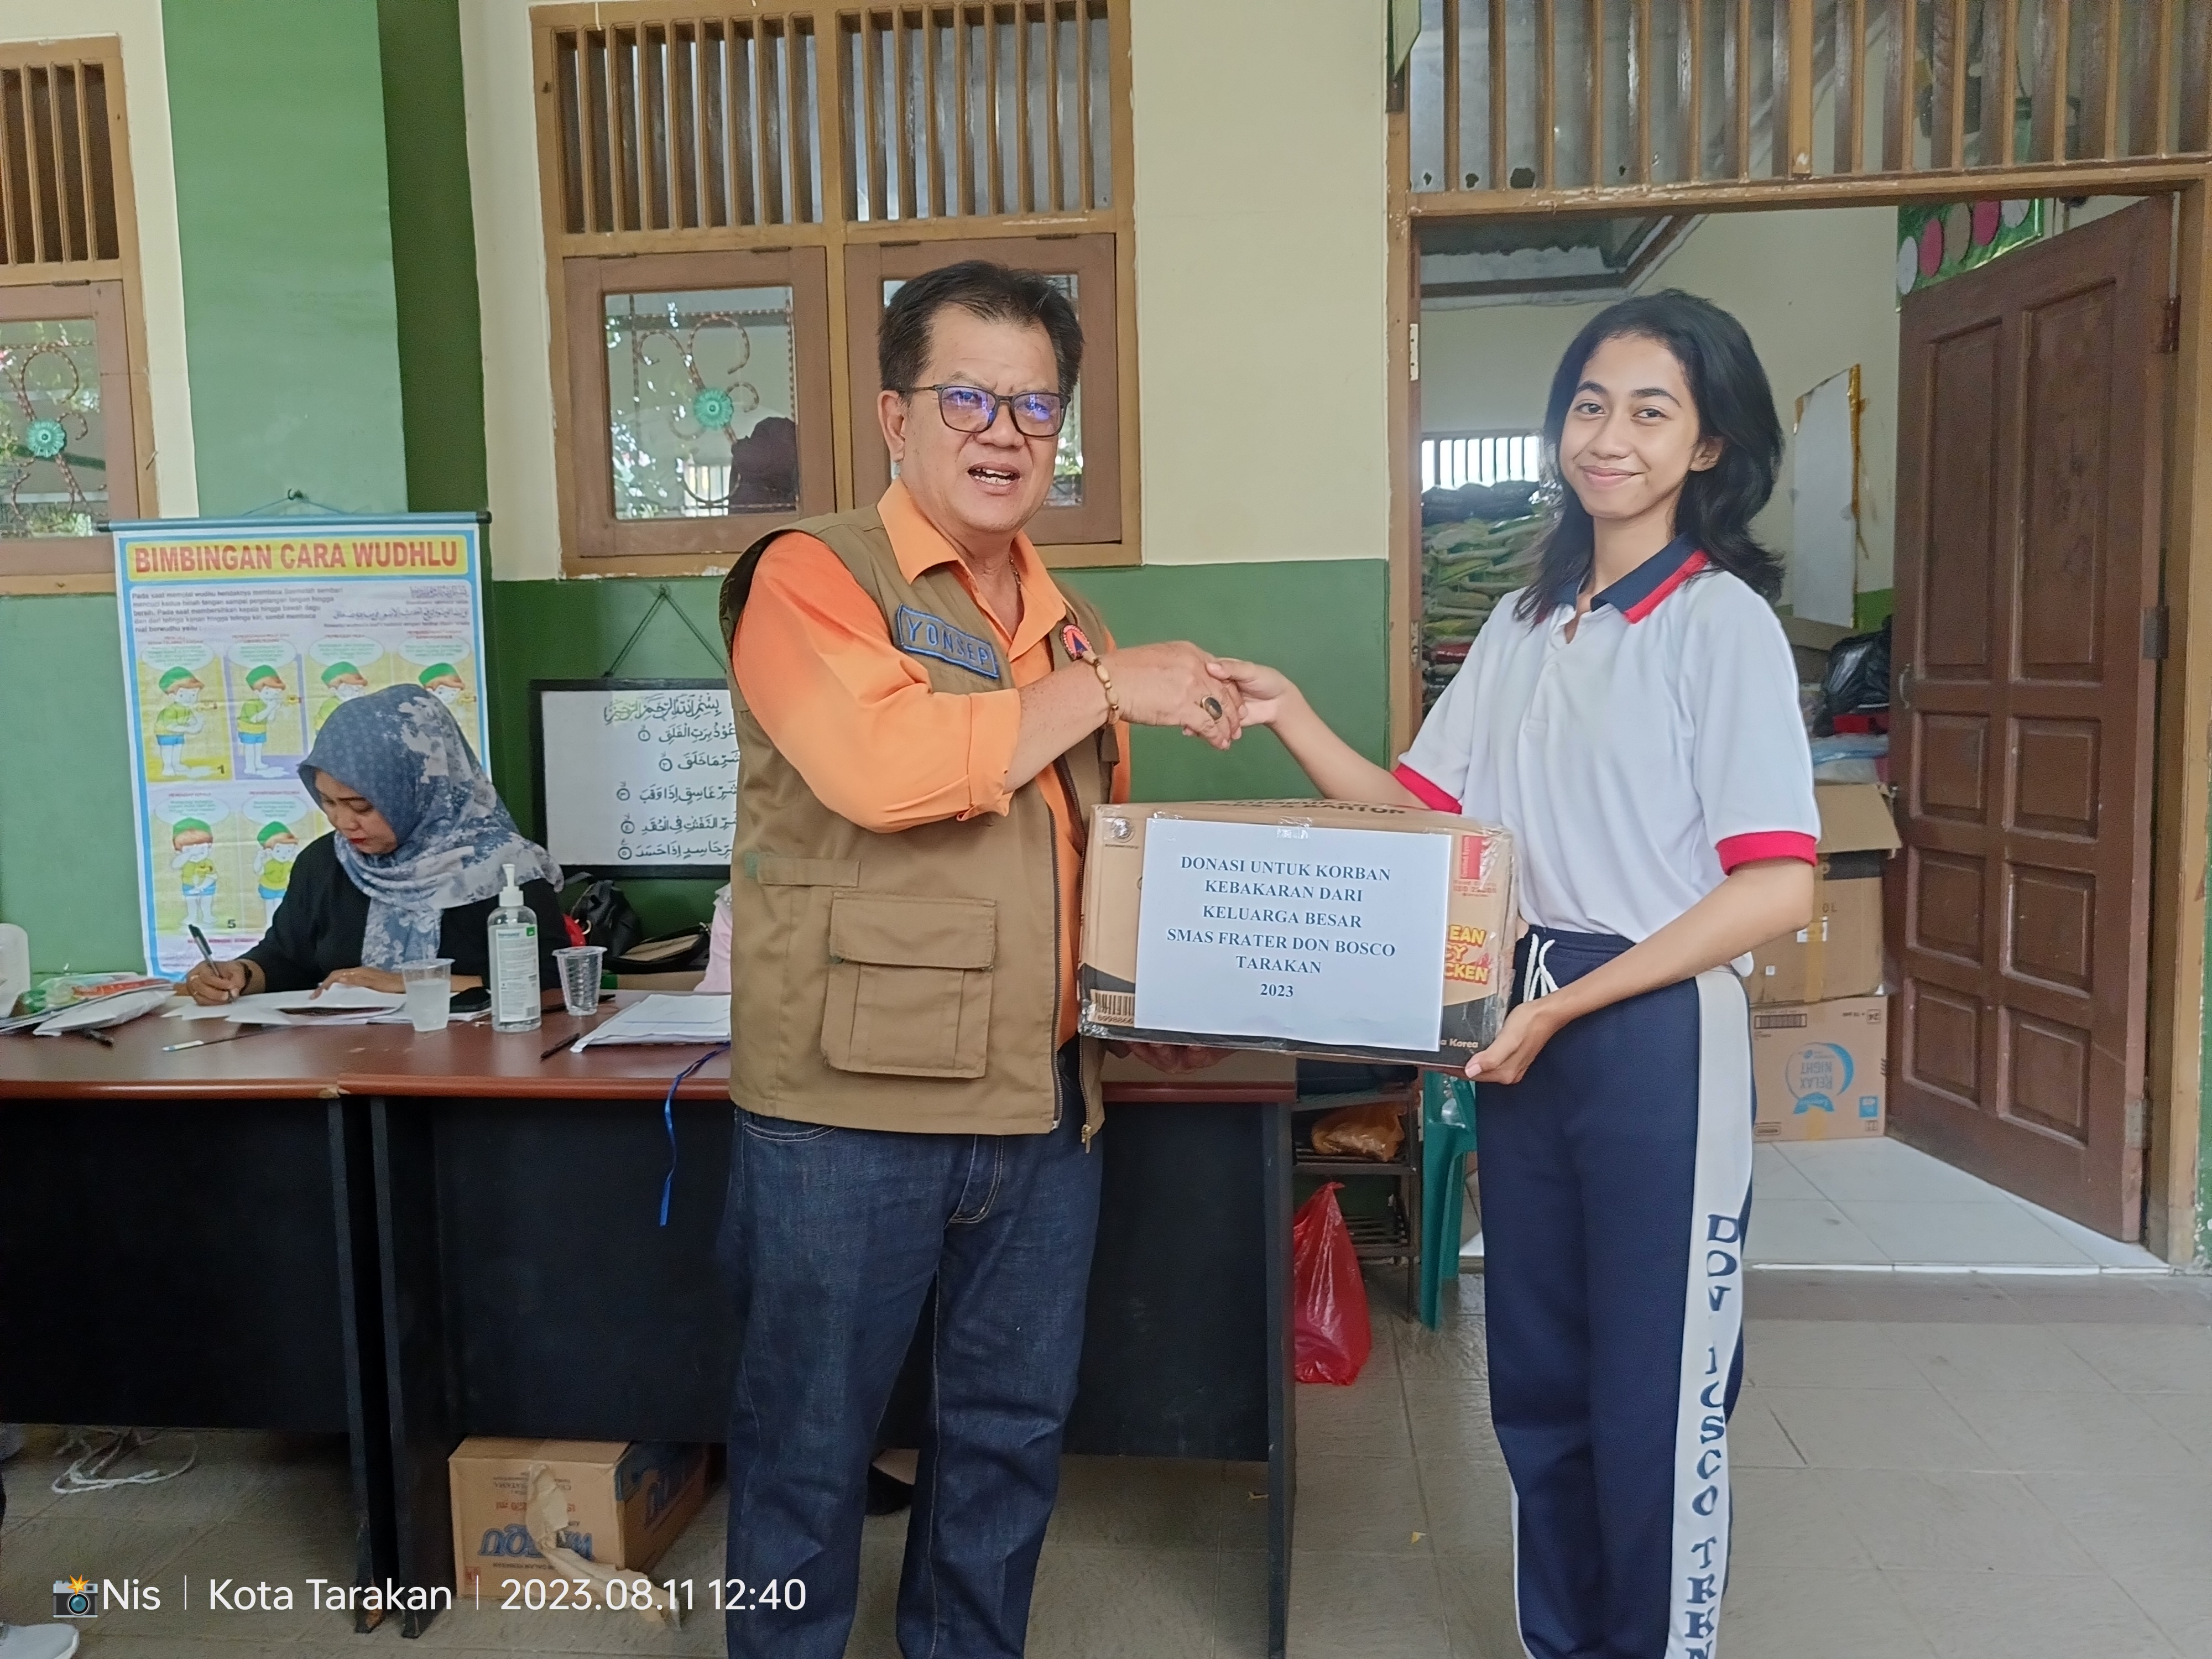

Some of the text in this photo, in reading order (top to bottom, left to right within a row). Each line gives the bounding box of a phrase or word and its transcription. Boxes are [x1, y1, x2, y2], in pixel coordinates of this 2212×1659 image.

[134, 541, 457, 573] BIMBINGAN CARA WUDHLU
[907, 616, 990, 665] YONSEP
[217, 764, 225, 774] 1
[1181, 856, 1391, 881] DONASI UNTUK KORBAN
[1204, 880, 1363, 902] KEBAKARAN DARI
[227, 920, 236, 928] 5
[1203, 905, 1362, 928] KELUARGA BESAR
[1167, 928, 1395, 957] SMAS FRATER DON BOSCO
[1449, 925, 1486, 947] EAN
[1236, 956, 1321, 973] TARAKAN
[1444, 962, 1489, 984] CKEN
[1260, 983, 1293, 997] 2023
[1449, 1037, 1479, 1048] Korea
